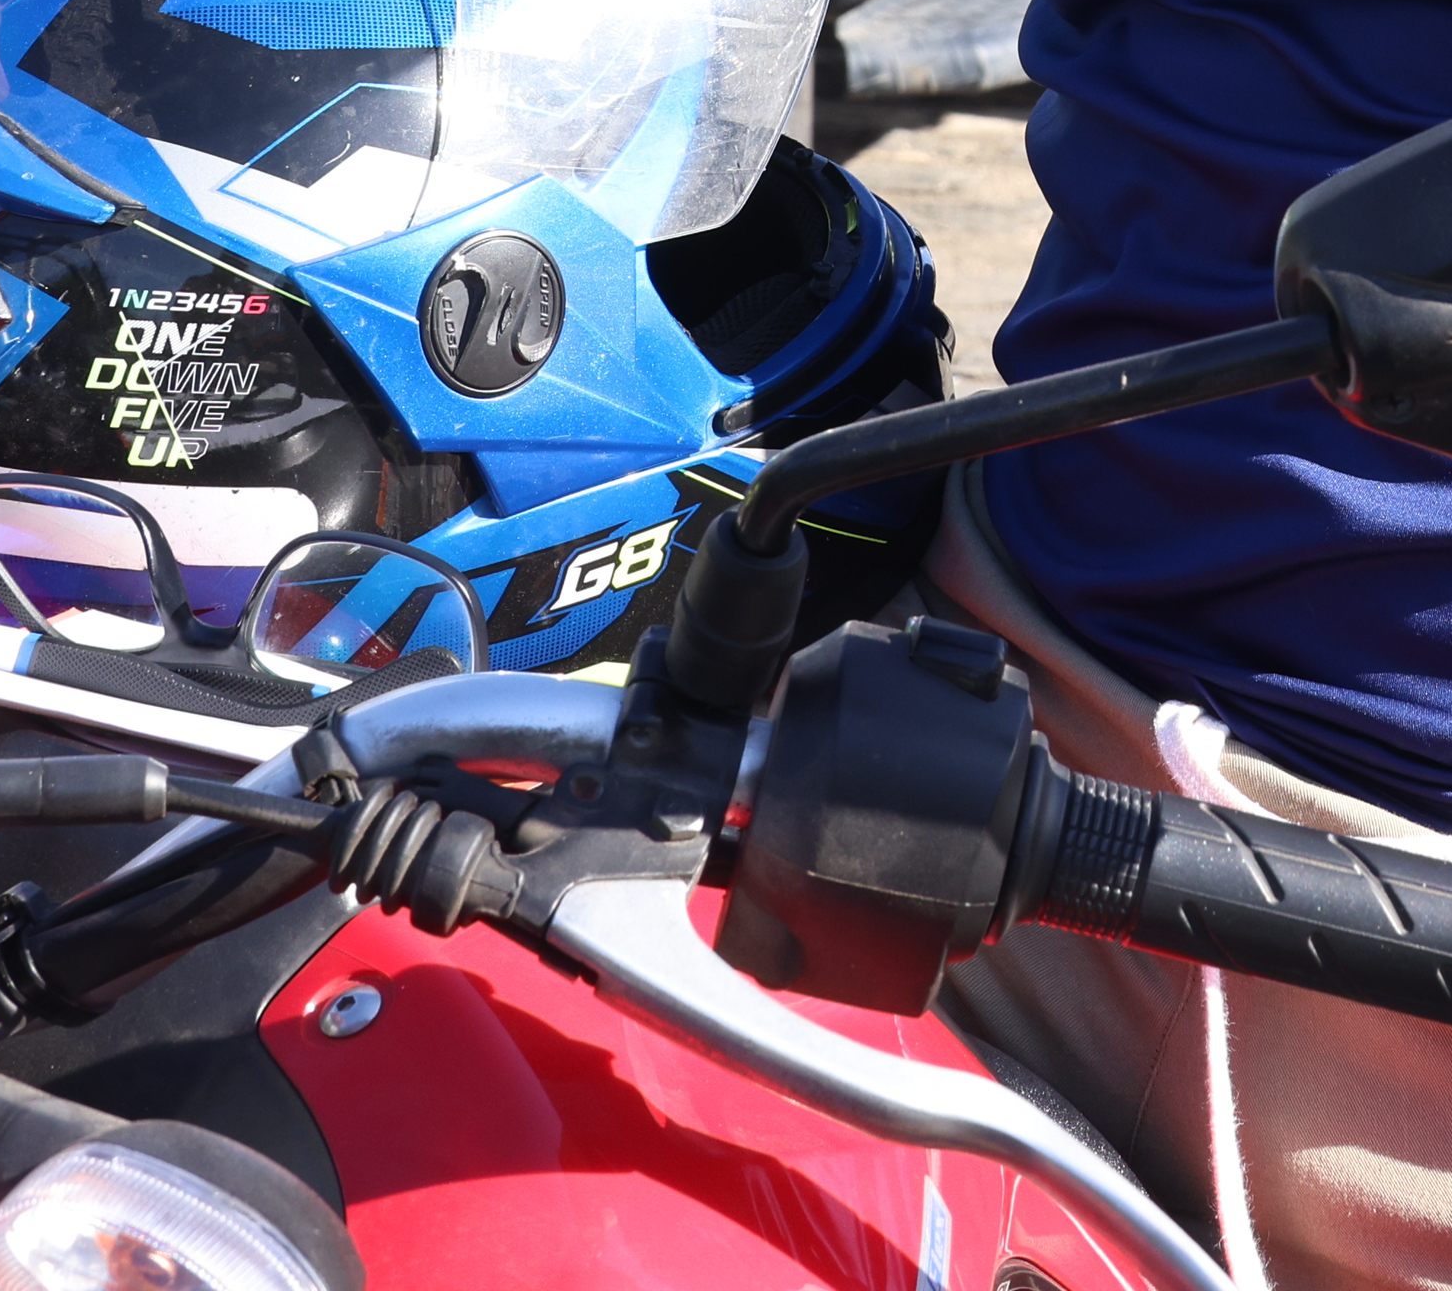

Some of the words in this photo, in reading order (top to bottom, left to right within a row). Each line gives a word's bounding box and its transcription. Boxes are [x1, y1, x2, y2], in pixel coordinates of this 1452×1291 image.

[539, 273, 551, 328] OPEN
[114, 319, 233, 357] ONE
[442, 296, 460, 357] CLOSE
[84, 357, 260, 396] DOWN
[109, 397, 231, 433] FIVE
[126, 434, 210, 469] UP
[549, 519, 679, 611] G8
